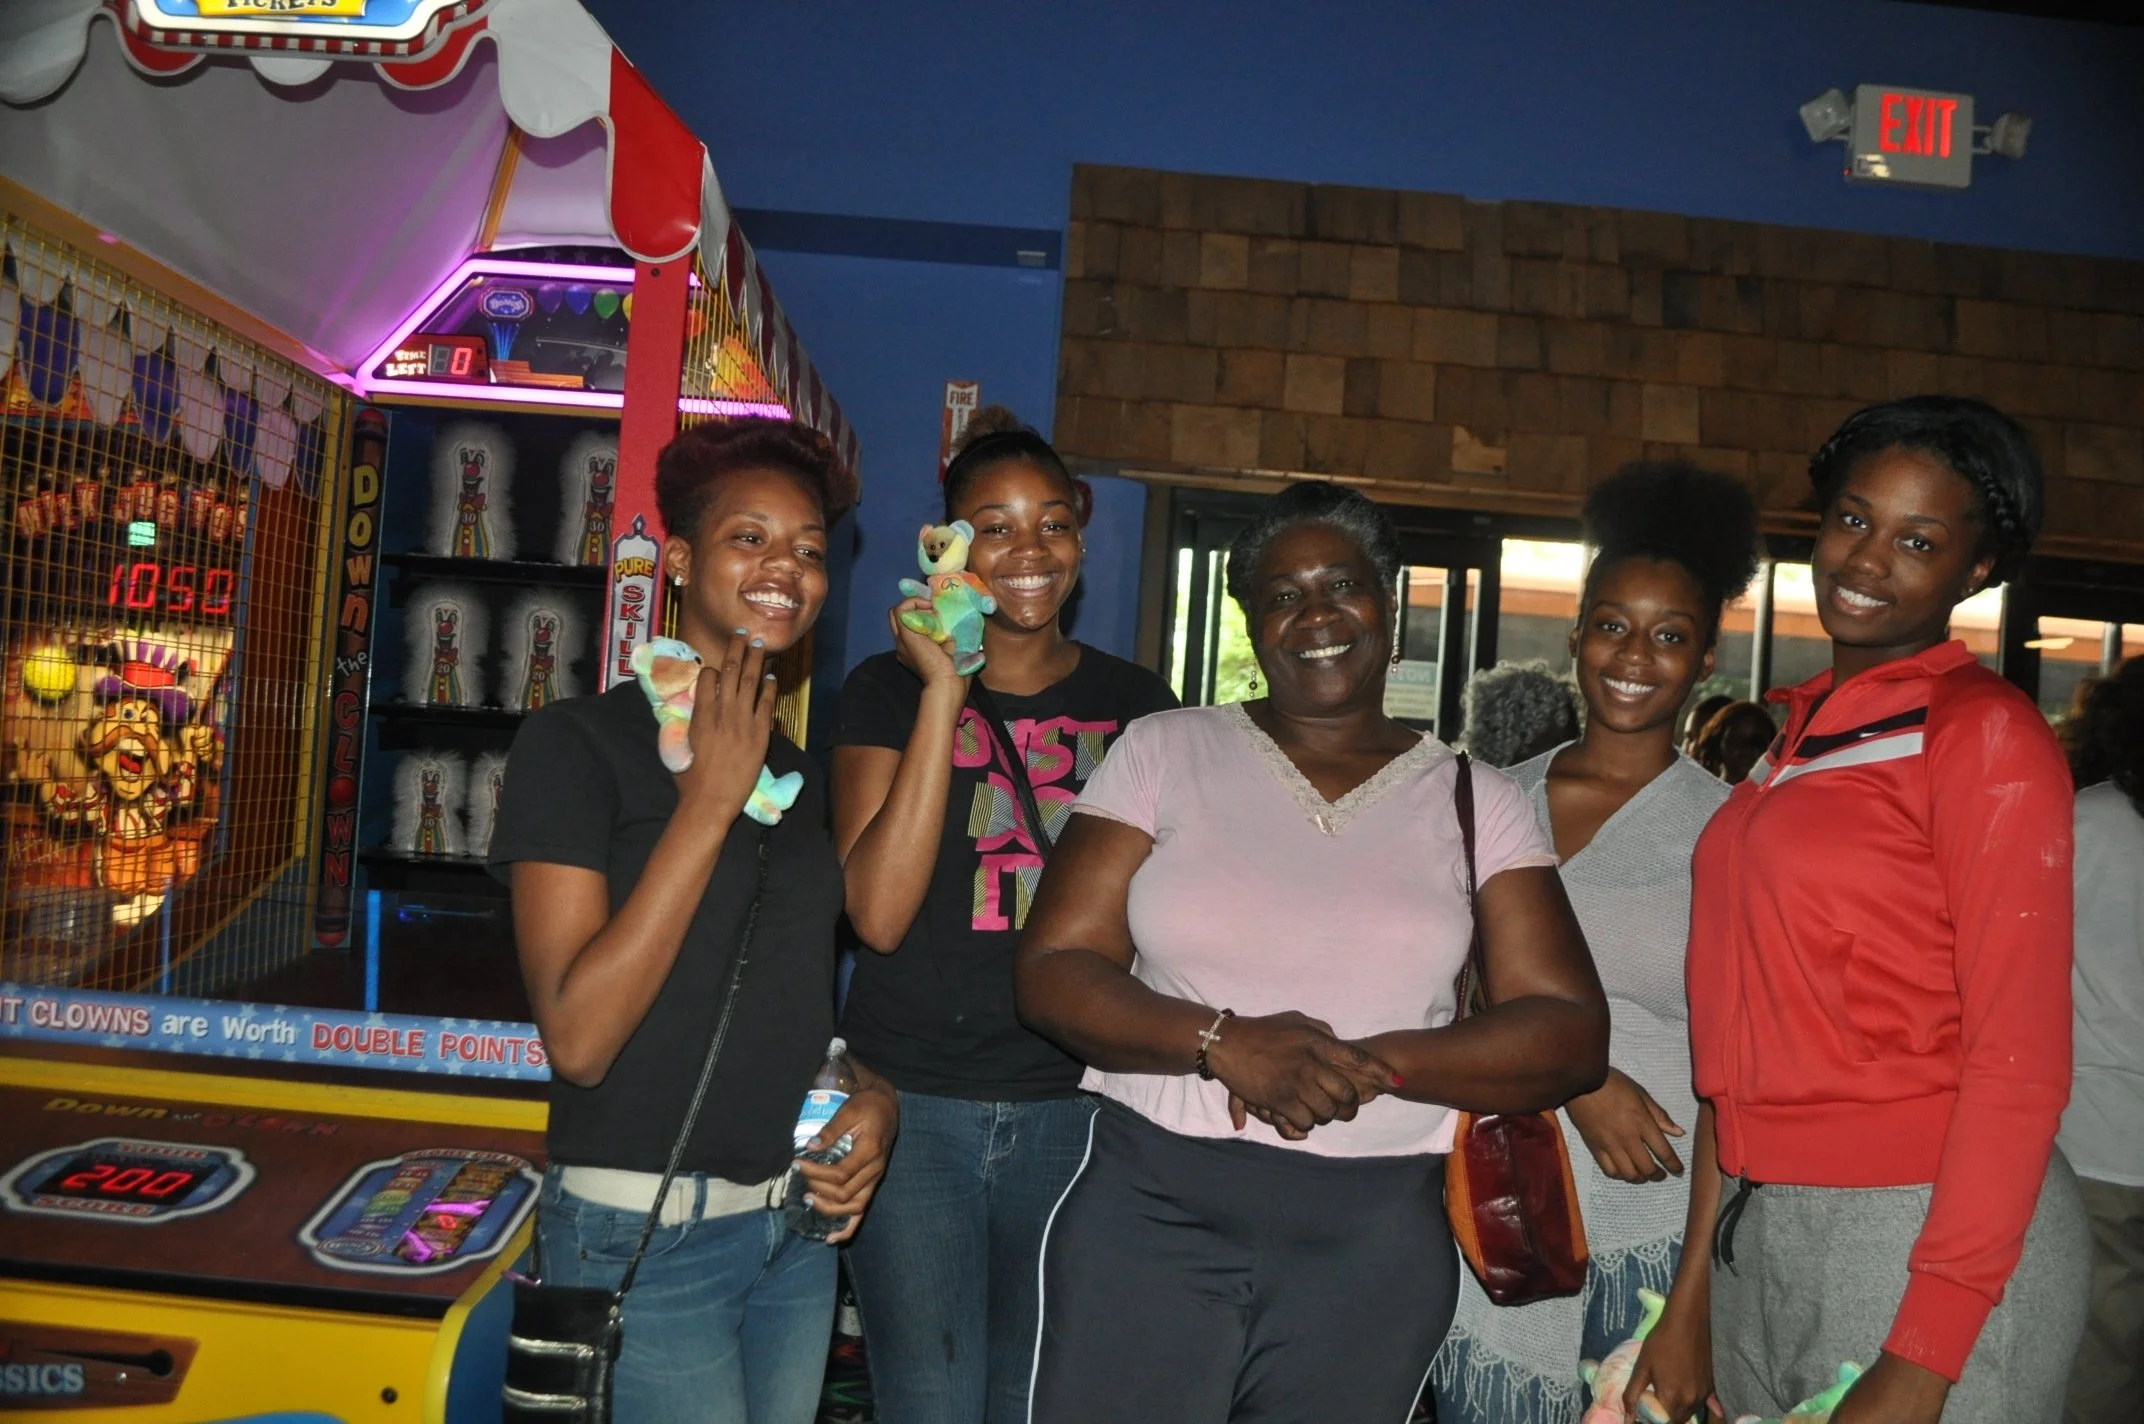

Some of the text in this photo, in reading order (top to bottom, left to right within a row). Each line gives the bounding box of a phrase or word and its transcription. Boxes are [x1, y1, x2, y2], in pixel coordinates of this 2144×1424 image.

[1879, 92, 1958, 159] EXIT
[394, 350, 427, 361] TIME
[386, 363, 427, 377] LEFT
[950, 391, 974, 405] FIRE
[112, 481, 180, 528] JUG
[461, 511, 477, 525] 30
[589, 520, 605, 532] 30
[614, 556, 655, 583] PURE
[110, 562, 236, 615] 1050
[617, 584, 646, 678] SKILL
[337, 651, 369, 677] the
[437, 662, 450, 674] 20
[532, 670, 545, 681] 20
[324, 690, 360, 888] CLOWN
[31, 999, 151, 1036] CLOWNS
[161, 1014, 208, 1037] are
[222, 1015, 296, 1045] Worth
[312, 1022, 425, 1058] DOUBLE
[62, 1164, 193, 1197] 200
[34, 1195, 154, 1216] SCORE
